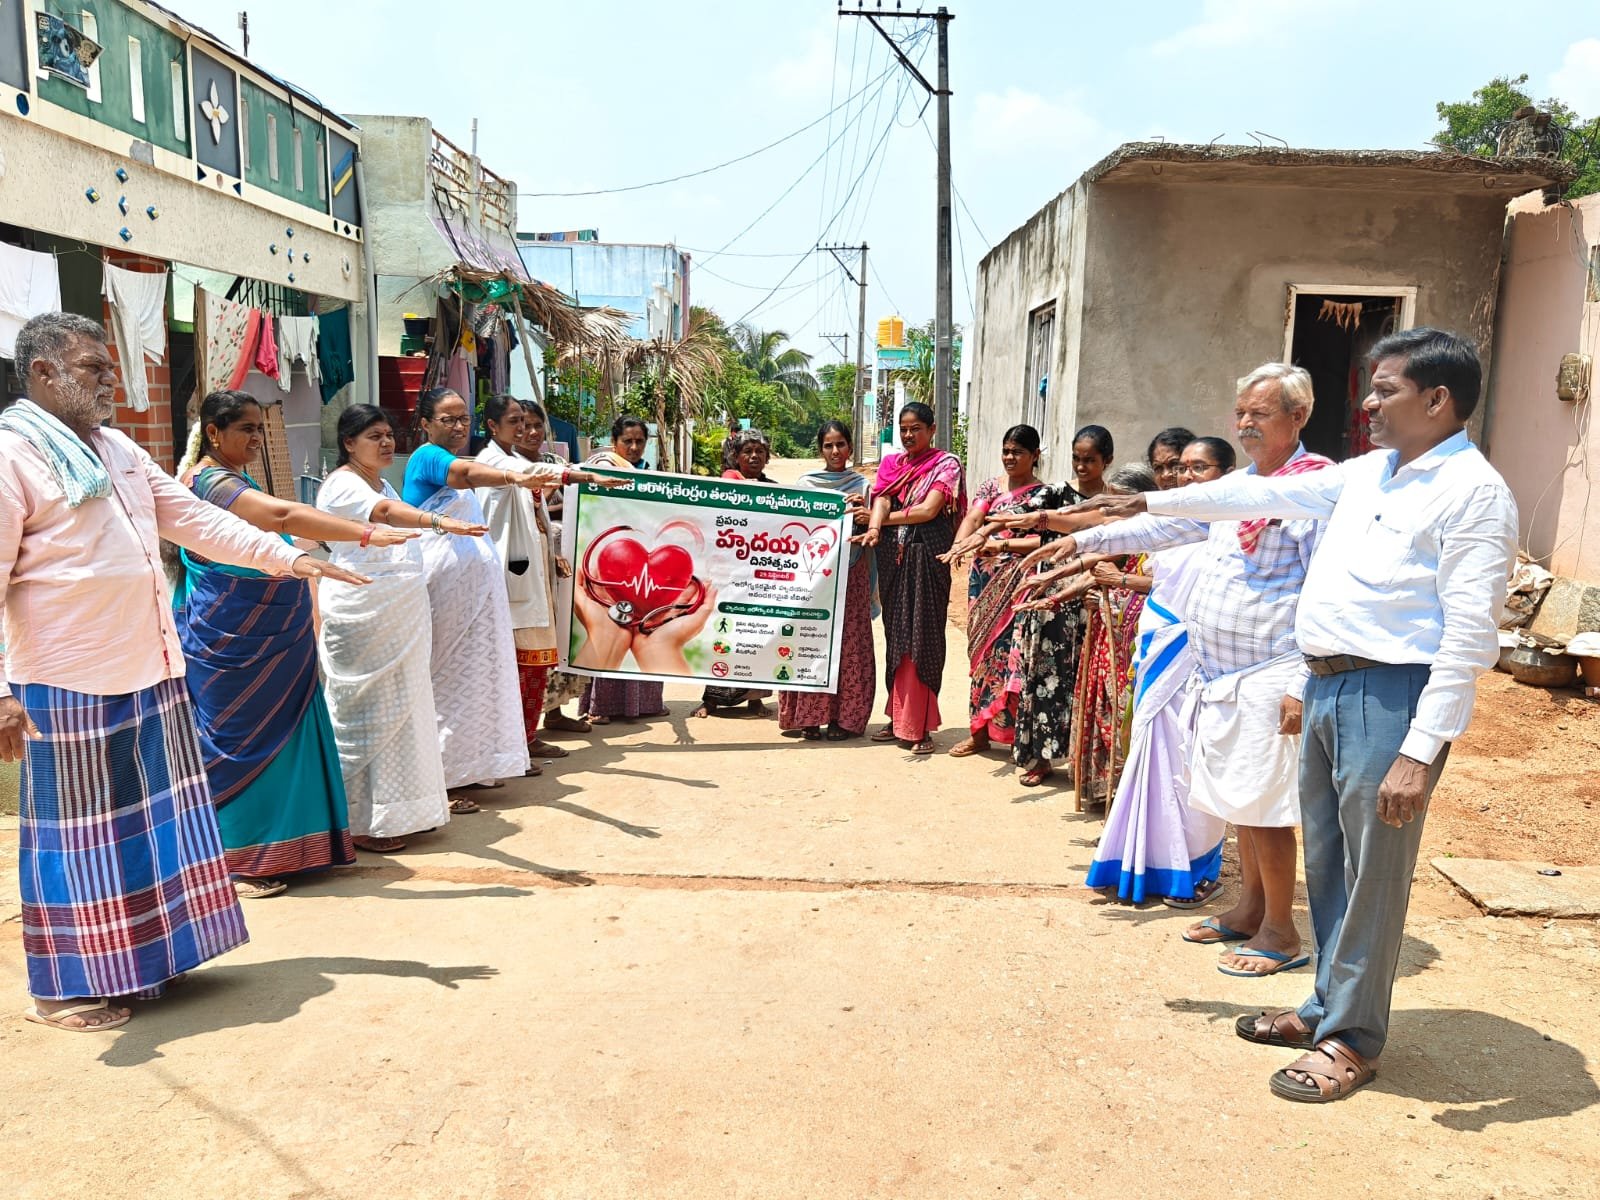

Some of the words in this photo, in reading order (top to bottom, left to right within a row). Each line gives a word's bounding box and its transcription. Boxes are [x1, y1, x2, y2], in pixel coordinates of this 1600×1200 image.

[637, 481, 708, 501] ఆరోగ్యకేంద్రం
[709, 486, 753, 505] తలపుల,
[756, 492, 811, 513] అన్నమయ్య
[715, 515, 748, 527] ప్రపంచ
[715, 528, 800, 560] హృదయ
